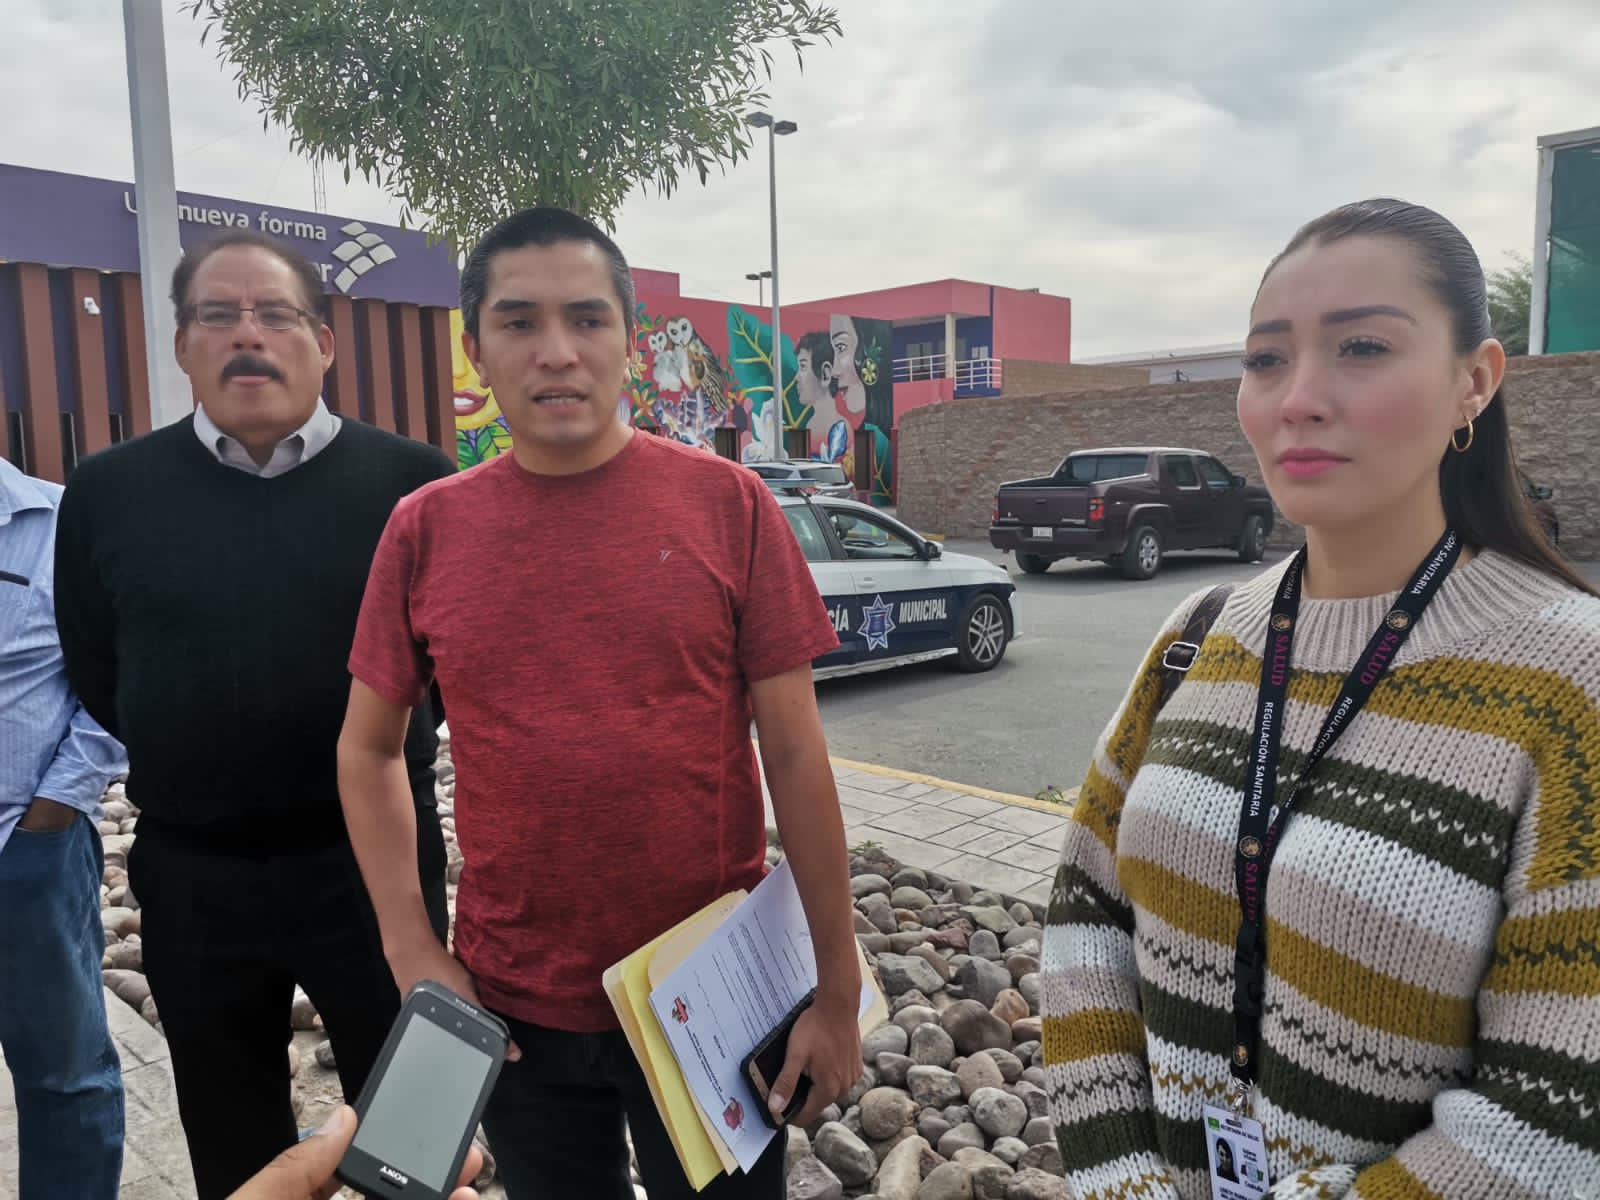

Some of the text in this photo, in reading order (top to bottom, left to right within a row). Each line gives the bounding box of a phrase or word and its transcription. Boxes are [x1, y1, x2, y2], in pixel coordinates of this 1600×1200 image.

[178, 203, 327, 241] nueva forma
[1410, 550, 1447, 595] SANITARIA
[898, 598, 948, 624] MUNICIPAL
[1271, 633, 1289, 687] SALUD
[1360, 632, 1398, 686] SALUD
[1249, 764, 1266, 817] SANITARIA
[379, 1165, 409, 1185] SONY
